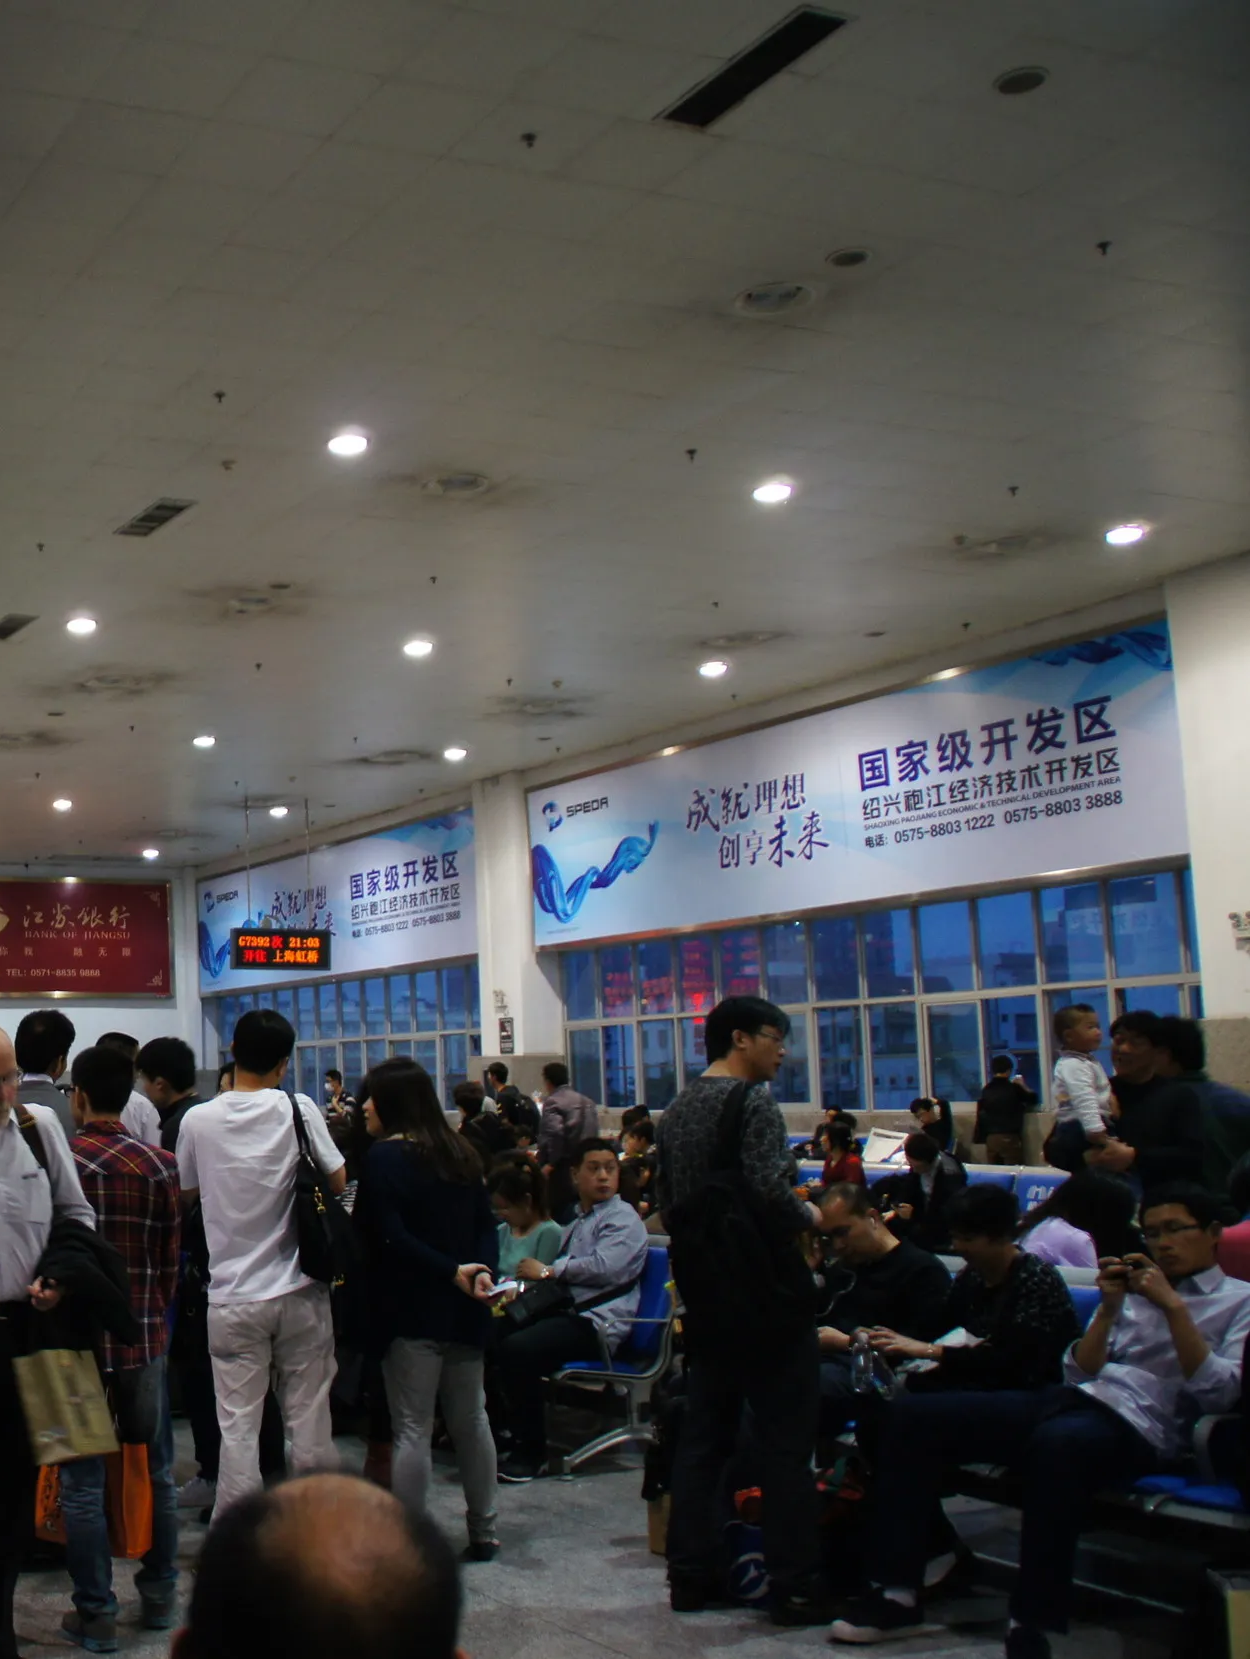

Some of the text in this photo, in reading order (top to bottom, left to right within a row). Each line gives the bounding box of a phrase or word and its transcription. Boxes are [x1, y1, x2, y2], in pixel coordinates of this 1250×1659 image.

[858, 695, 1117, 792] 国家级开发区
[566, 796, 609, 818] SPEDA
[686, 772, 807, 833] 成就理想
[862, 747, 1121, 821] 绍兴袍江经济技术开发区
[864, 819, 900, 831] SHAOXING
[901, 811, 938, 824] PAOJIANG
[938, 803, 979, 817] ECONOMIC
[986, 792, 1031, 808] TECHNICAL
[1032, 780, 1096, 799] DEVELOPMENT
[1097, 776, 1122, 787] AREA
[894, 820, 962, 844] 0575-8803
[965, 814, 995, 831] 1222
[1004, 798, 1081, 824] 0575-8803
[1085, 790, 1123, 810] 3888
[350, 850, 459, 900] 国家级开发区
[25, 930, 130, 940] BANK OF JIANGSU
[243, 950, 319, 963] 开往 上海虹桥
[289, 936, 320, 948] 21:03
[6, 968, 27, 977] TEL:
[30, 968, 77, 977] 0571-8835
[79, 969, 101, 977] 9888
